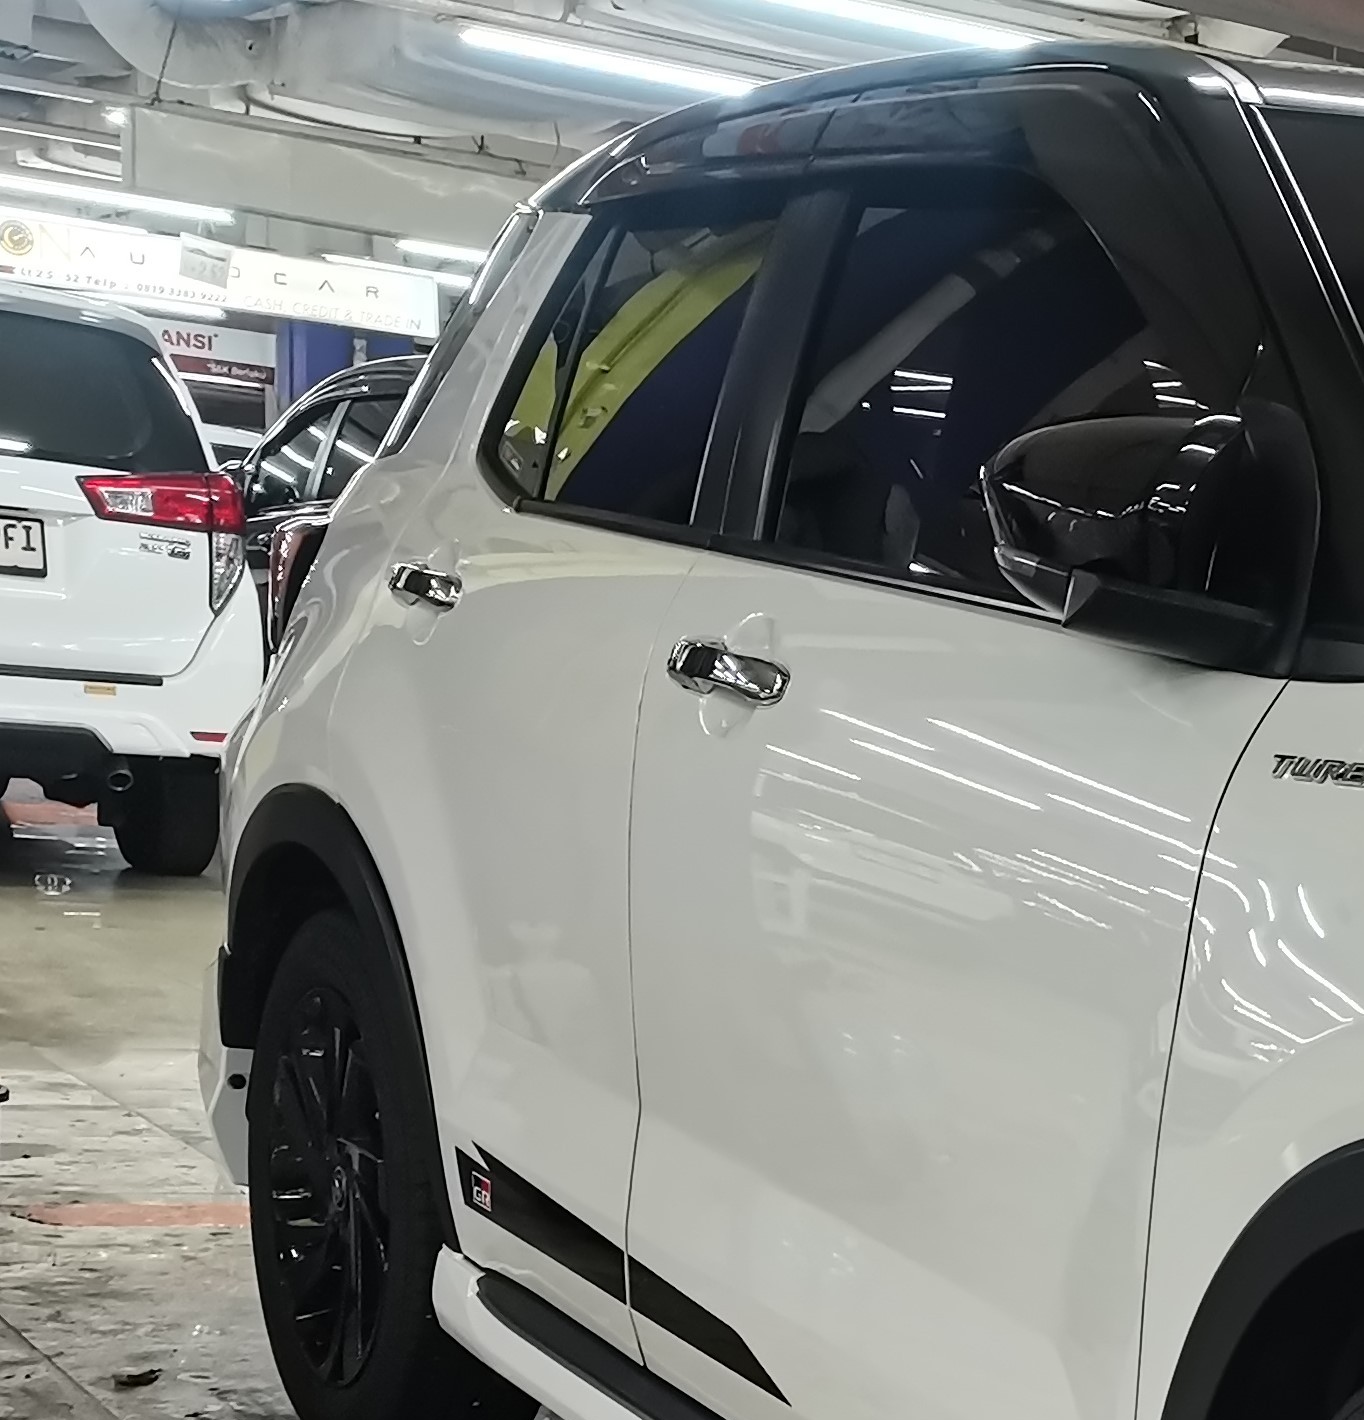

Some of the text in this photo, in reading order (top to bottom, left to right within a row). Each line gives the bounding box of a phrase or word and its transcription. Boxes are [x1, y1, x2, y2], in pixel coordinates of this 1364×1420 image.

[86, 275, 117, 289] Telp
[292, 301, 339, 320] CREDIT
[360, 310, 401, 328] TRADE
[405, 318, 422, 331] IN
